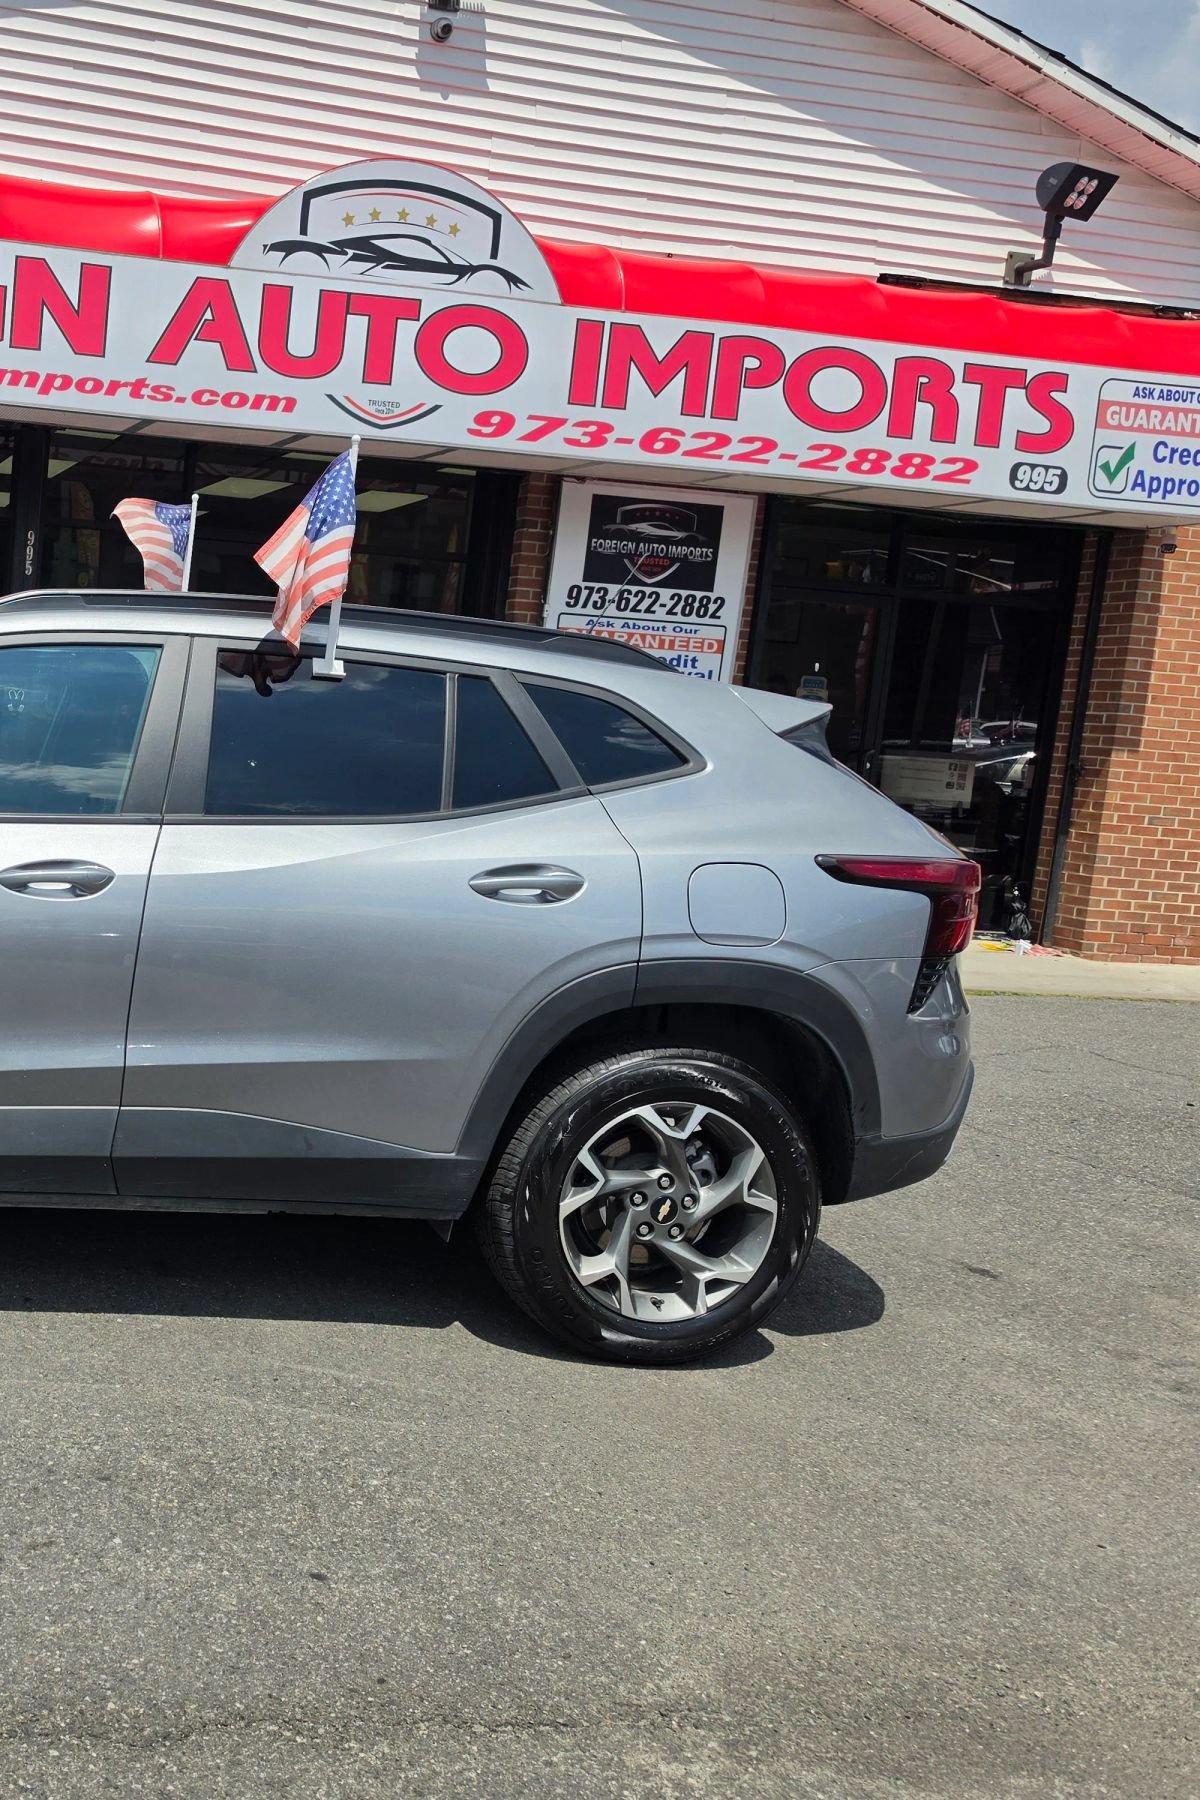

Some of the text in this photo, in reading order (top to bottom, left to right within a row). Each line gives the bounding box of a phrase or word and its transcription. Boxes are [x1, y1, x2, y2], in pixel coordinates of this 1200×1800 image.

[146, 275, 530, 396] AUTO
[567, 318, 1075, 454] IMPORTS
[367, 399, 400, 409] TRUSTED
[1133, 386, 1156, 400] ASK
[1157, 388, 1195, 404] ABOUT
[466, 410, 979, 486] 973-622-2882
[1014, 464, 1062, 492] 995
[25, 530, 35, 576] 995
[591, 538, 714, 561] FOREIGN AUTO IMPORTS
[565, 584, 726, 620] 973-622-2882
[585, 619, 701, 635] Ask About Our
